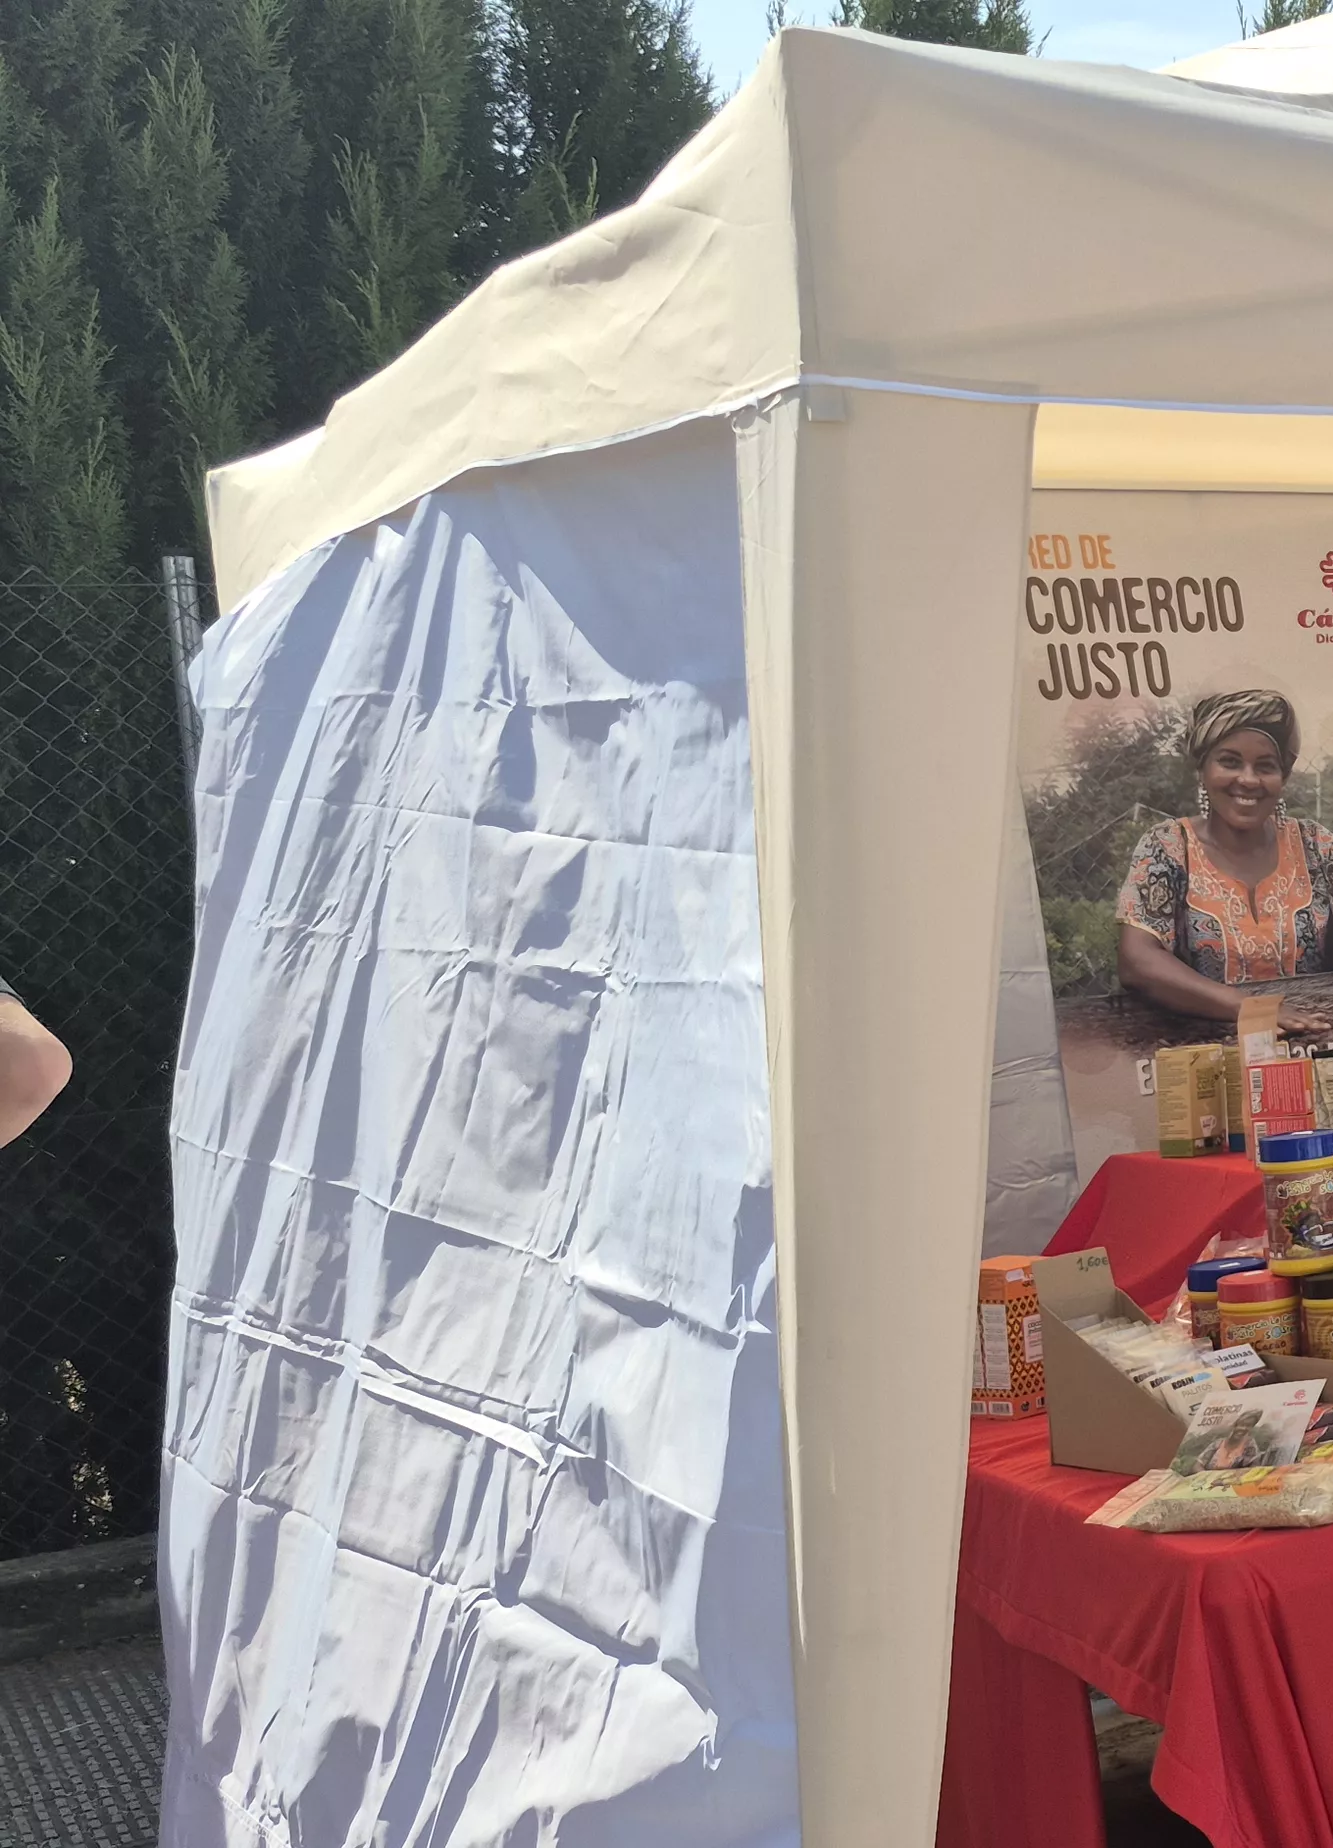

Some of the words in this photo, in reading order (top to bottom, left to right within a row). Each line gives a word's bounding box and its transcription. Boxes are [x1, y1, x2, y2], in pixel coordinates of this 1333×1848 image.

[1078, 534, 1116, 570] DE
[1026, 576, 1244, 635] COMERCIO
[1038, 641, 1171, 700] JUSTO
[1182, 1383, 1213, 1397] PALITOS
[1203, 1404, 1243, 1416] COMERCIO
